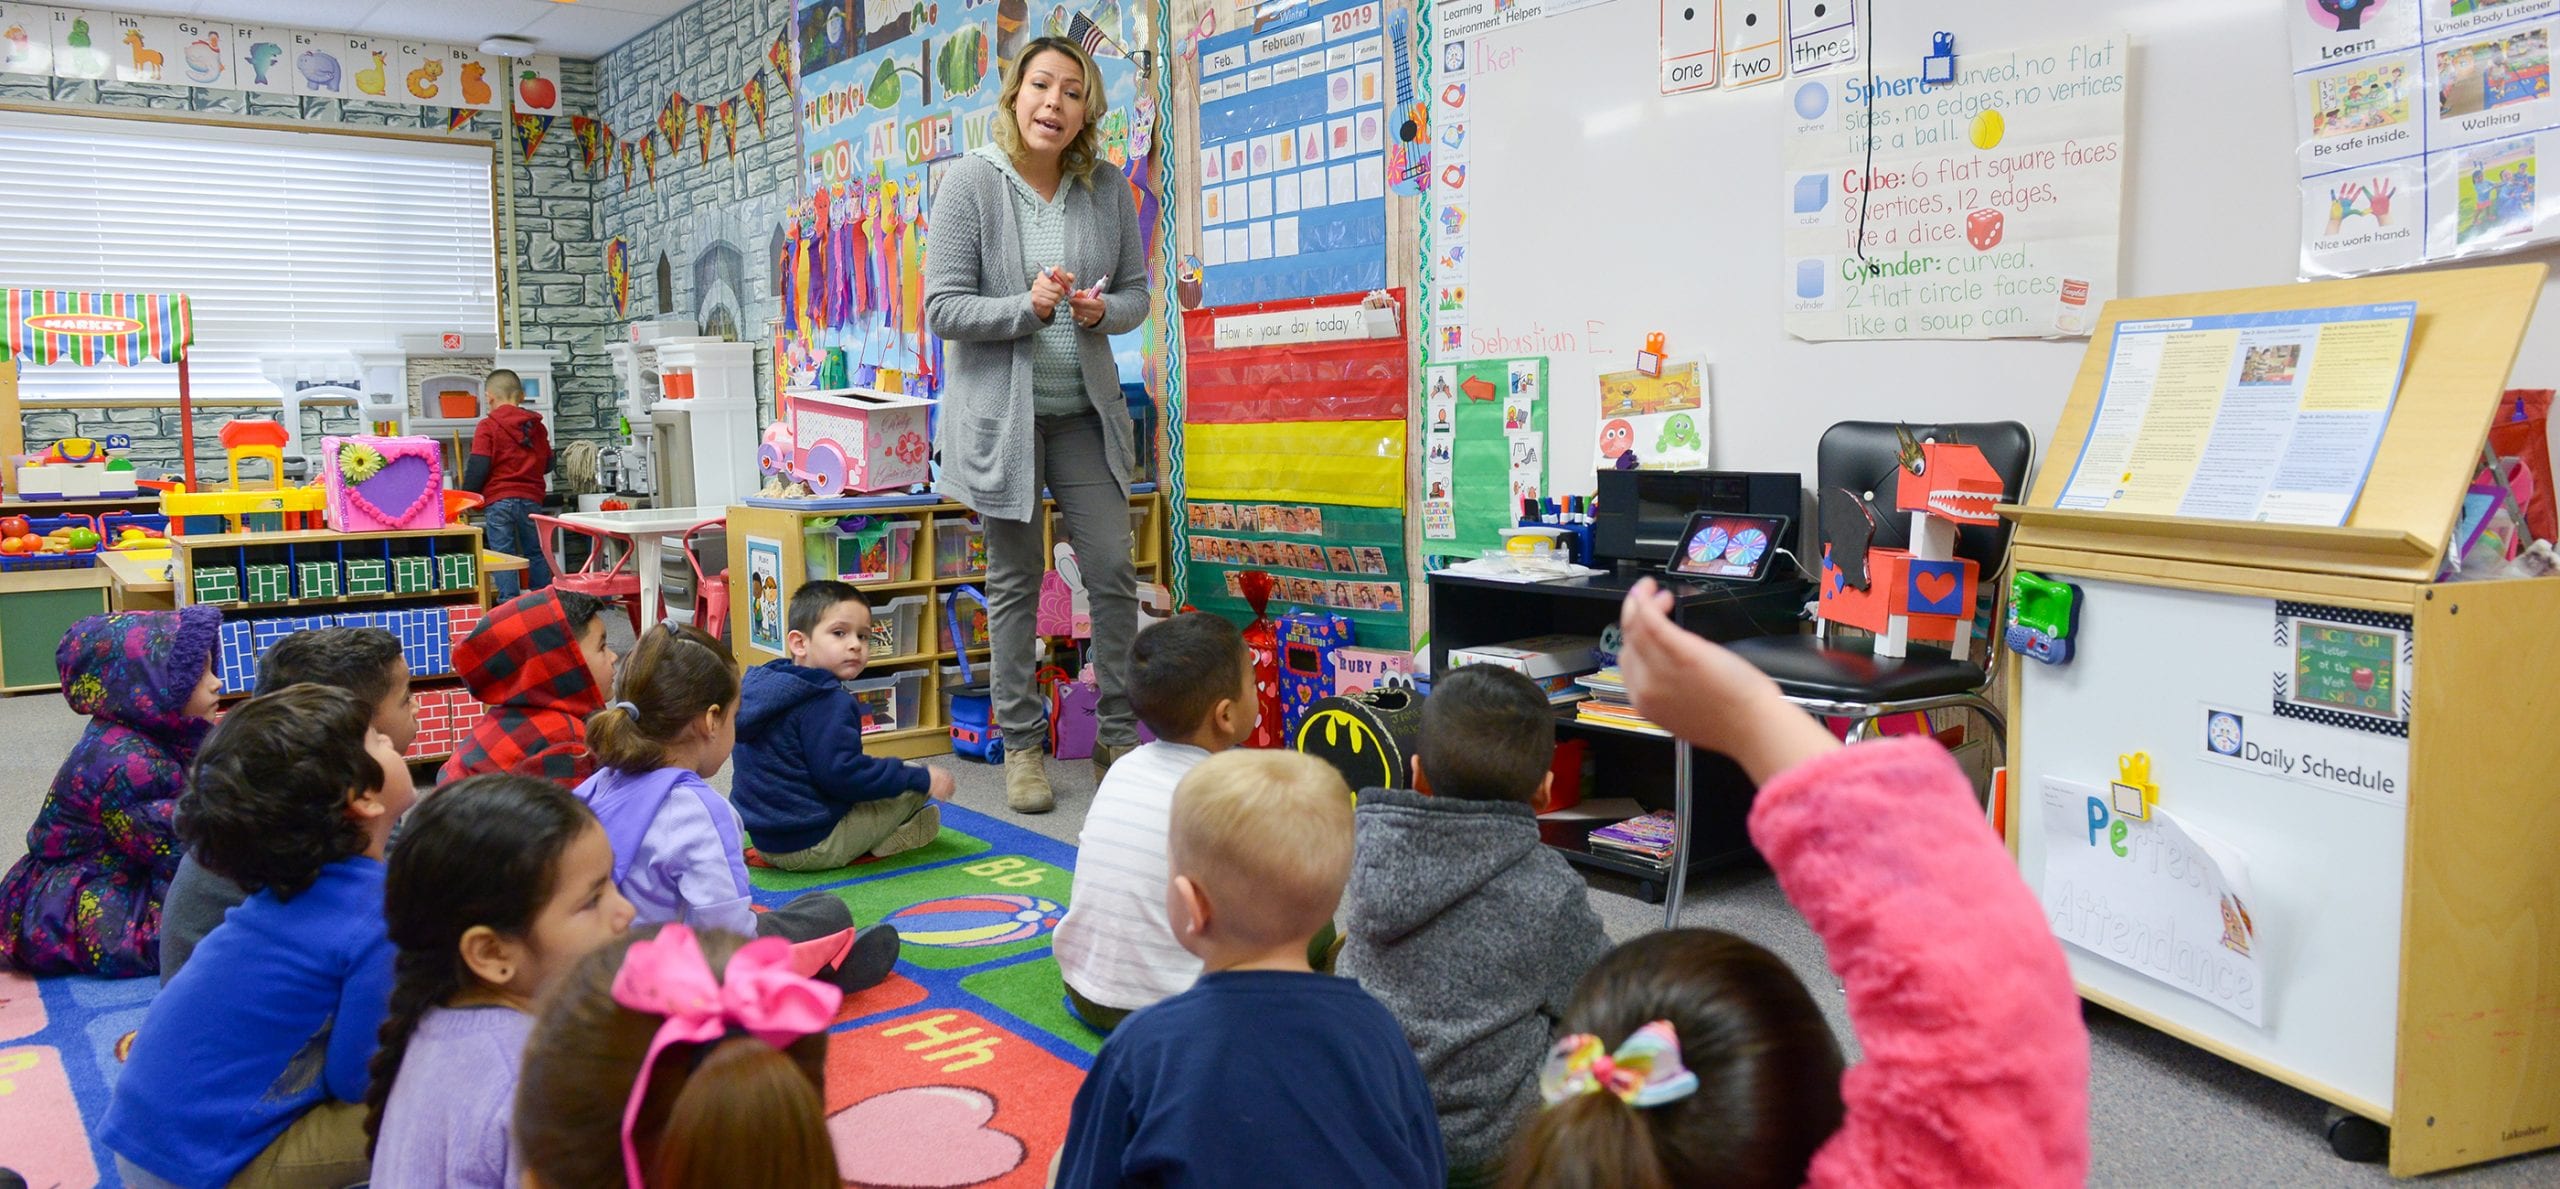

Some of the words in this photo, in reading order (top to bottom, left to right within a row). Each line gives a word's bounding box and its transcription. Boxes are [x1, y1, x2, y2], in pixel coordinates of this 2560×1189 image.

[54, 12, 66, 22] Ii
[119, 18, 138, 28] Hh
[1332, 6, 1372, 33] 2019
[1443, 16, 1500, 39] Environment
[1506, 5, 1542, 24] Helpers
[1444, 2, 1483, 22] Learning
[2434, 19, 2470, 34] Whole
[2473, 10, 2503, 26] Body
[2506, 0, 2551, 17] Listener
[179, 23, 198, 35] Gg
[239, 29, 253, 39] Ff
[296, 35, 311, 45] Ee
[350, 40, 367, 50] Dd
[402, 45, 417, 55] Cc
[1262, 31, 1305, 53] February
[1795, 38, 1850, 65] three
[2321, 38, 2377, 60] Learn
[453, 50, 468, 60] Bb
[516, 56, 531, 67] Aa
[1213, 53, 1234, 69] Feb.
[1473, 37, 1524, 76] Iker
[2025, 56, 2056, 77] no
[2067, 40, 2115, 73] flat
[1672, 63, 1703, 83] one
[1732, 57, 1771, 79] two
[1905, 103, 1930, 122] no
[1937, 88, 2010, 120] edges,
[2014, 85, 2041, 105] no
[2048, 72, 2123, 103] vertices
[1797, 122, 1825, 134] sphere
[2462, 110, 2521, 132] Walking
[1849, 132, 1882, 154] like
[1892, 133, 1905, 149] a
[1915, 119, 1959, 147] ball.
[2314, 143, 2332, 157] Be
[2335, 138, 2363, 153] safe
[2367, 129, 2410, 147] inside.
[811, 140, 863, 185] LOOK
[873, 121, 895, 159] AT
[907, 117, 951, 162] OUR
[1843, 164, 1906, 194] Cube:
[1911, 161, 1928, 188] 6
[1936, 157, 1982, 184] flat
[1988, 147, 2056, 183] square
[2060, 139, 2118, 170] faces
[1844, 197, 1858, 224] 8
[1864, 189, 1953, 222] vertices,
[1959, 186, 1979, 211] 12
[1990, 181, 2058, 212] edges,
[1800, 215, 1820, 225] cube
[1846, 227, 1879, 249] like
[1885, 227, 1897, 245] a
[1908, 217, 1962, 245] dice.
[2314, 239, 2340, 252] Nice
[2342, 233, 2372, 247] work
[2374, 227, 2411, 242] hands
[1947, 243, 2034, 276] curved.
[1845, 286, 1862, 310] 2
[1872, 282, 1912, 309] flat
[1919, 278, 1982, 305] circle
[1994, 274, 2060, 303] faces,
[1794, 298, 1825, 313] cylinder
[44, 319, 126, 331] MARKET
[1220, 323, 1240, 341] How
[1246, 324, 1253, 339] is
[1260, 322, 1282, 343] your
[1291, 316, 1310, 337] day
[1315, 313, 1350, 336] today
[1354, 310, 1362, 330] ?
[1847, 312, 1886, 337] like
[1894, 316, 1908, 333] a
[1920, 312, 1974, 335] soup
[1981, 306, 2029, 327] can.
[1471, 320, 1576, 355] Sebastian
[1586, 320, 1614, 355] E.
[1340, 657, 1372, 674] RUBY
[1380, 661, 1388, 674] A
[2334, 662, 2351, 675] the
[2245, 741, 2296, 774] Daily
[2302, 754, 2395, 795] Schedule
[962, 856, 1048, 888] Bb
[2051, 880, 2254, 1011] Attendance
[880, 1013, 1003, 1073] Hh
